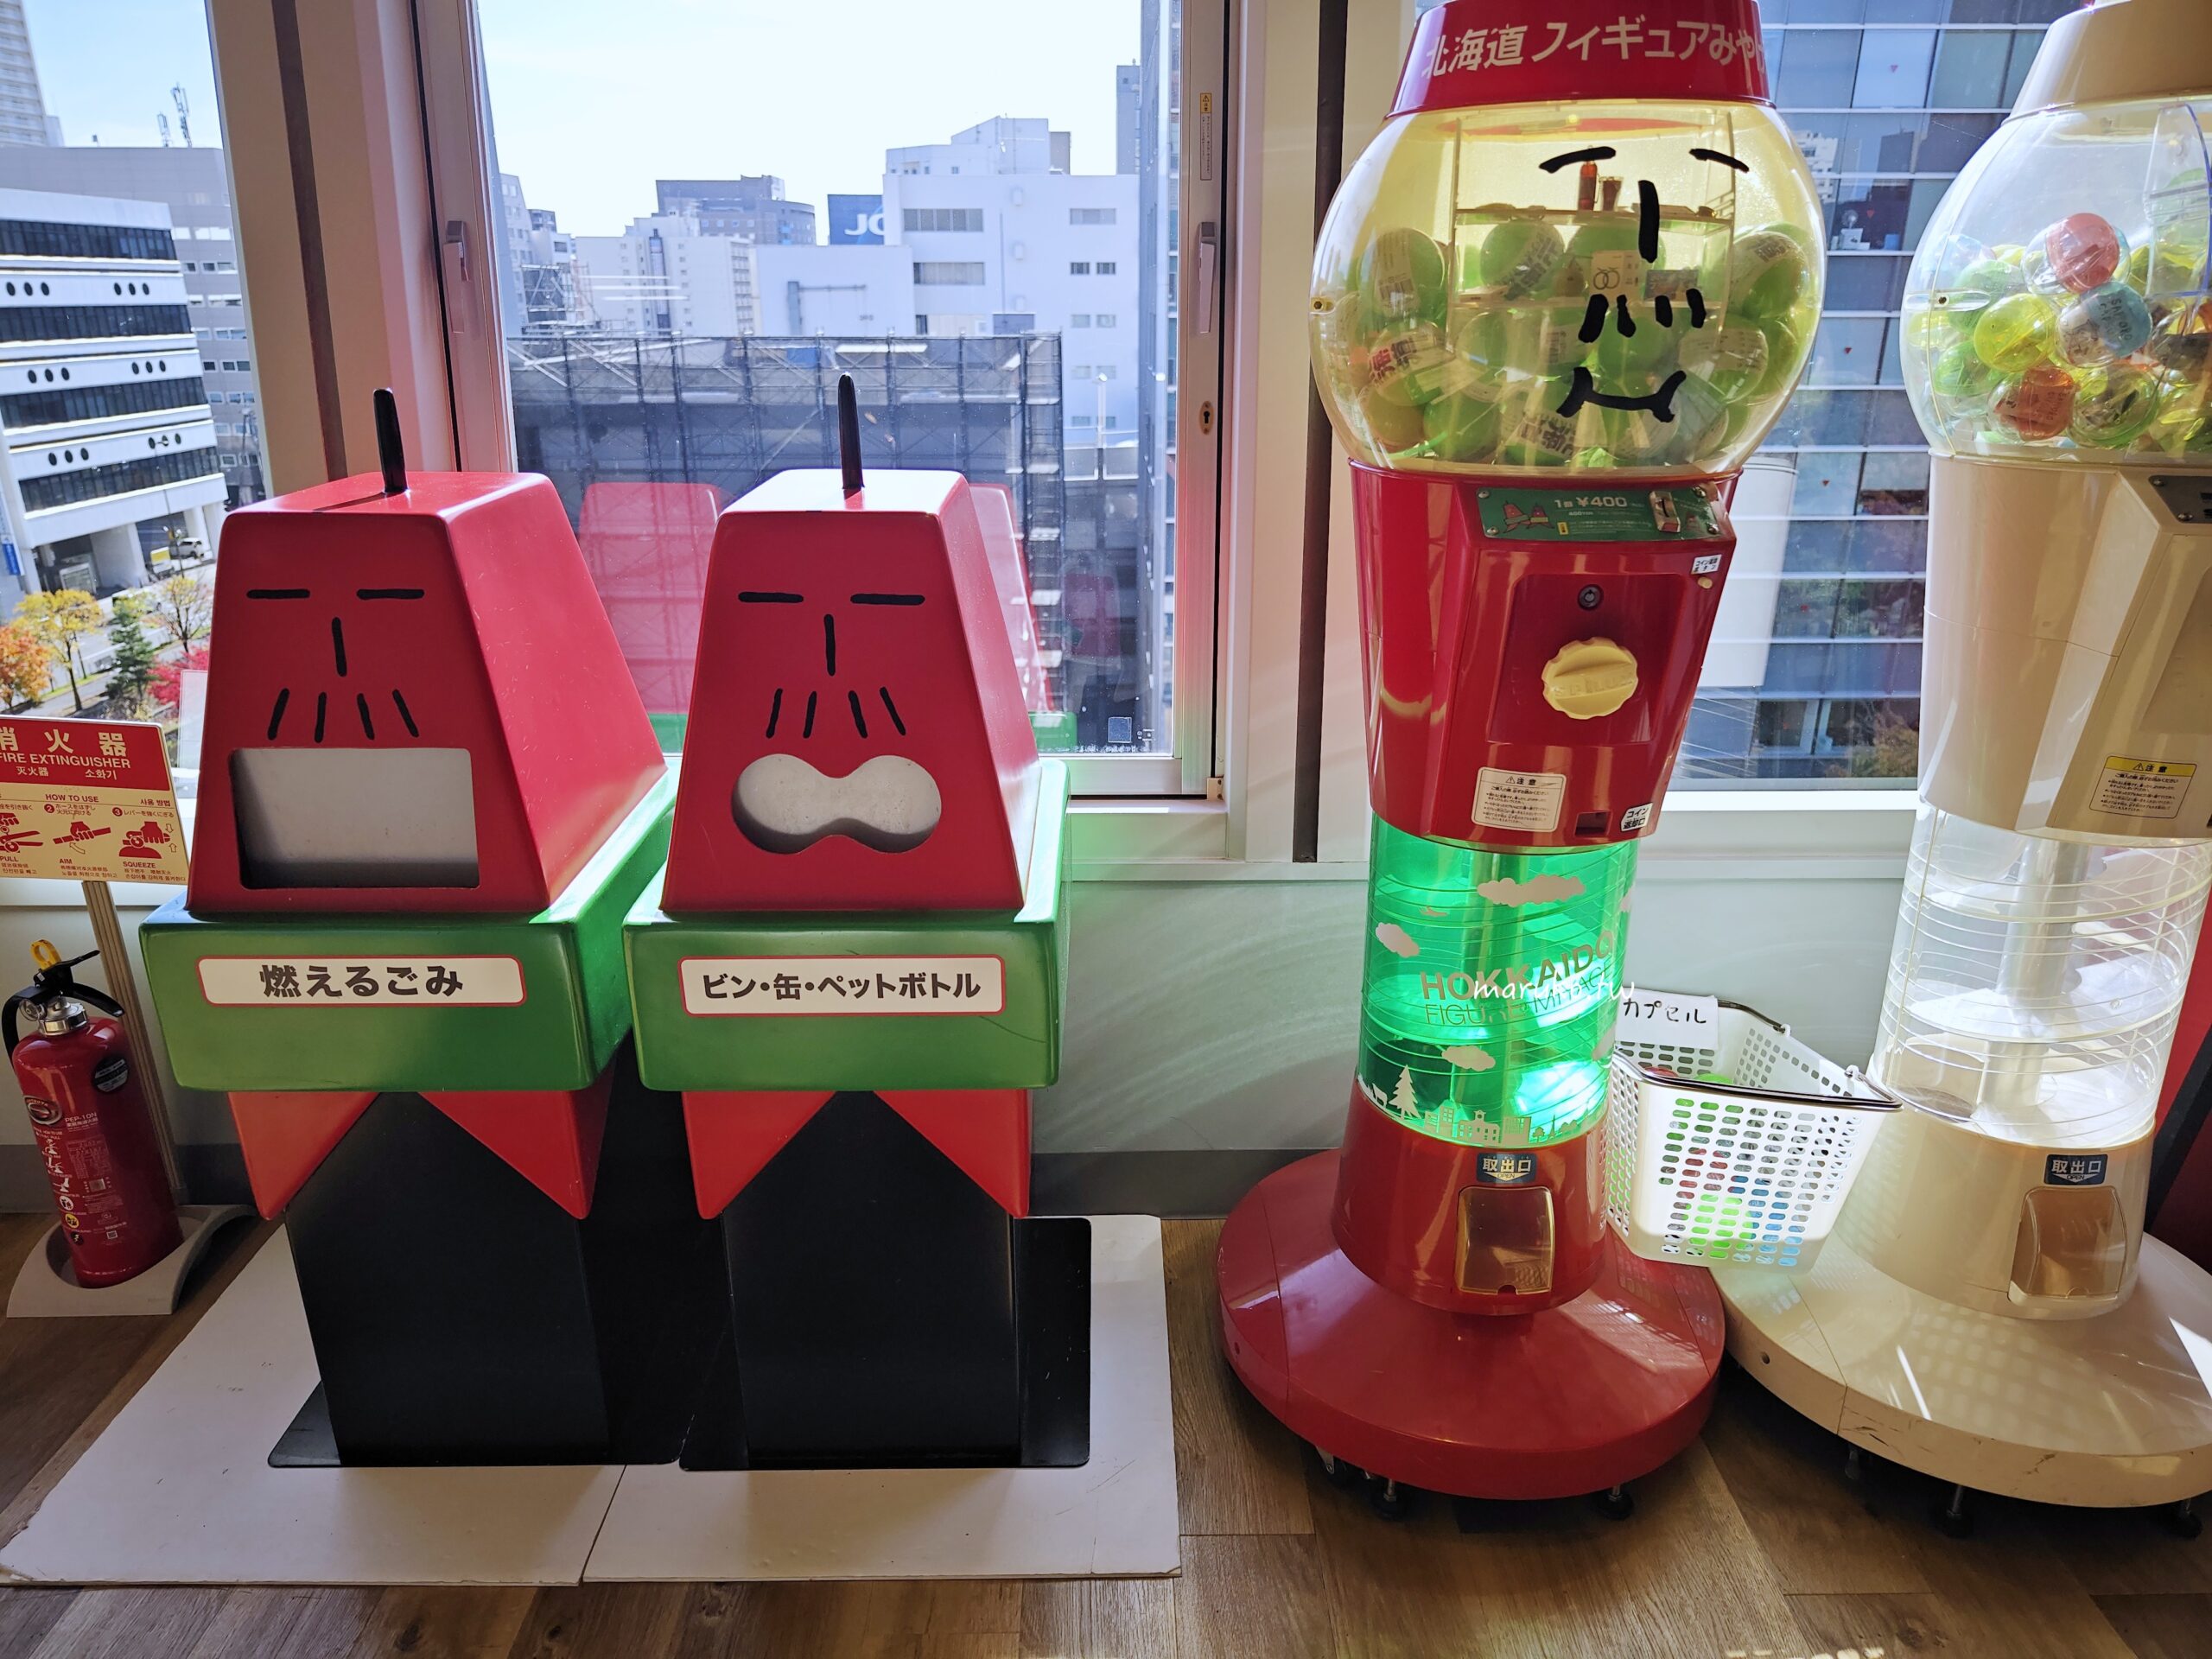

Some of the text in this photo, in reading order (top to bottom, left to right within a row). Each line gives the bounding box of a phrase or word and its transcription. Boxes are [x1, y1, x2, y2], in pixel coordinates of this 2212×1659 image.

[1576, 497, 1628, 507] ¥400
[29, 753, 130, 768] EXTINGUISHER
[16, 766, 48, 777] 灭火器
[85, 769, 118, 780] 소화기
[1626, 807, 1649, 818] コイン
[1420, 931, 1613, 1000] HOKKAIDO
[259, 964, 463, 997] 燃えるごみ
[702, 972, 982, 1000] ビン・缶・ペットボトル
[1624, 998, 1707, 1023] カプセル
[1483, 1158, 1531, 1172] 取出口
[2051, 1160, 2101, 1173] 取出口
